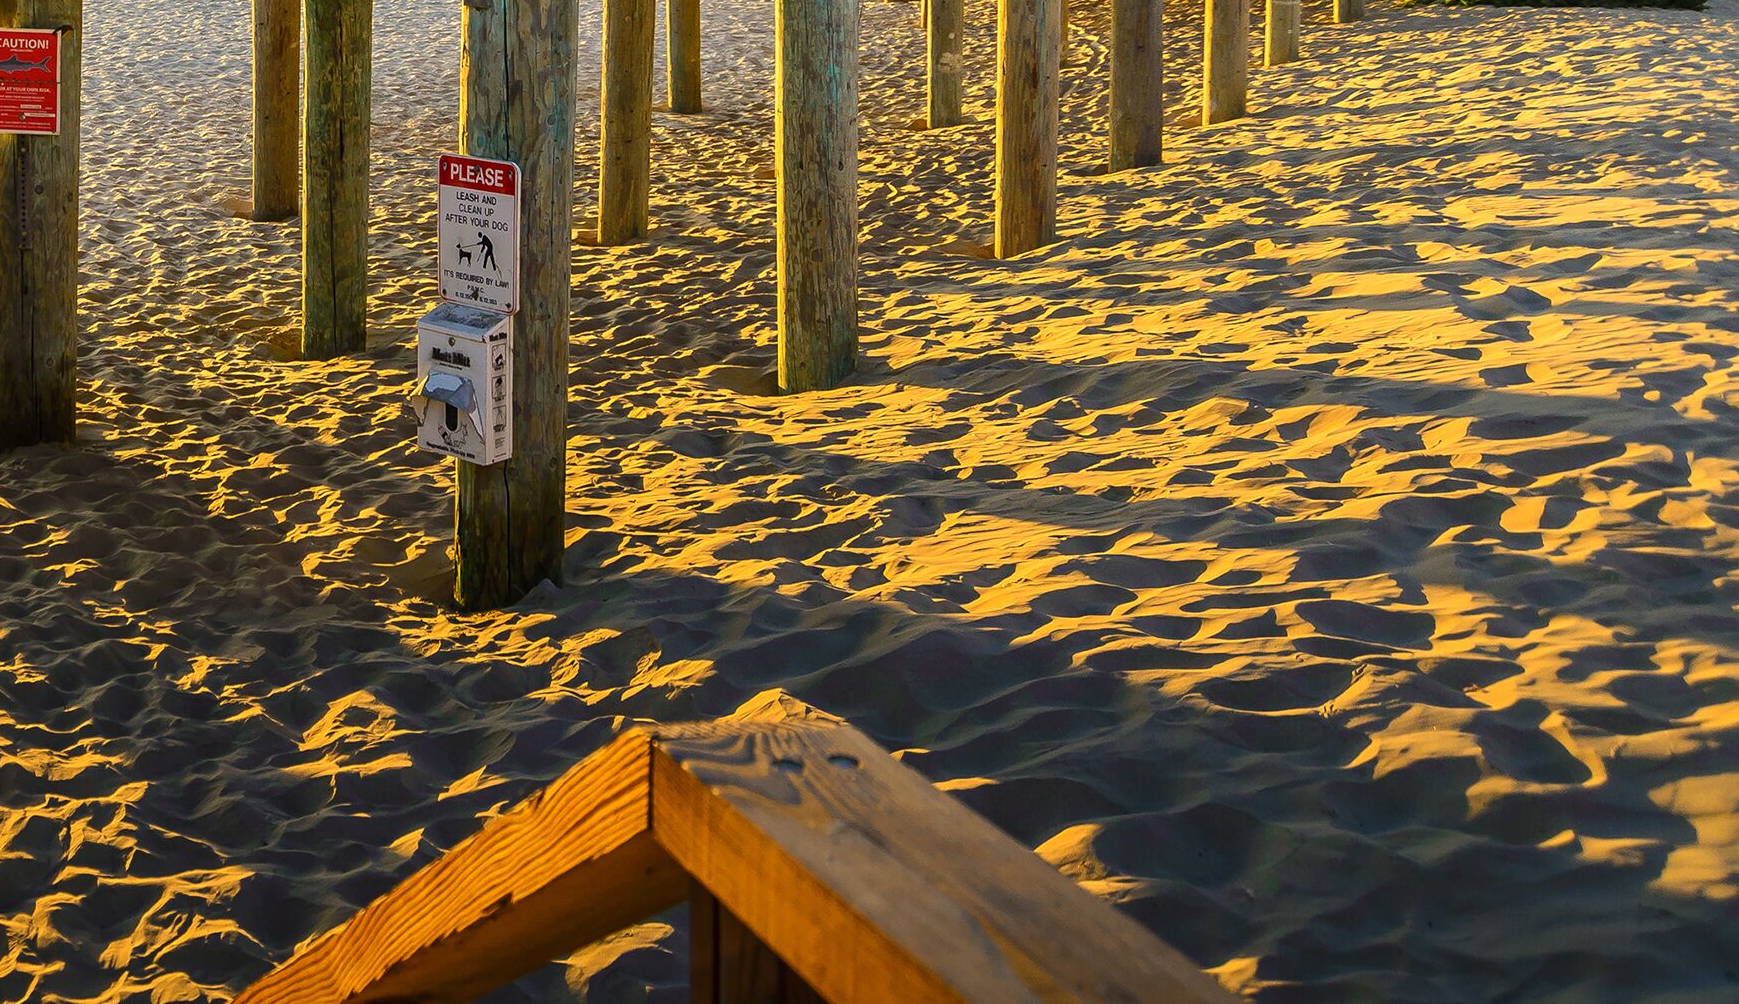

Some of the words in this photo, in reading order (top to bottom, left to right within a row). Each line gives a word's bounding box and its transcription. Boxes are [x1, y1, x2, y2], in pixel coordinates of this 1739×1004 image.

[450, 163, 504, 188] PLEASE
[456, 191, 480, 203] LEASH
[481, 195, 497, 206] AND
[458, 203, 482, 215] CLEAN
[484, 208, 495, 217] UP
[445, 213, 468, 225] AFTER
[469, 216, 490, 228] YOUR
[492, 221, 509, 232] DOG
[444, 269, 454, 278] IT'S
[455, 271, 485, 284] REQUIRED
[485, 277, 494, 286] BY
